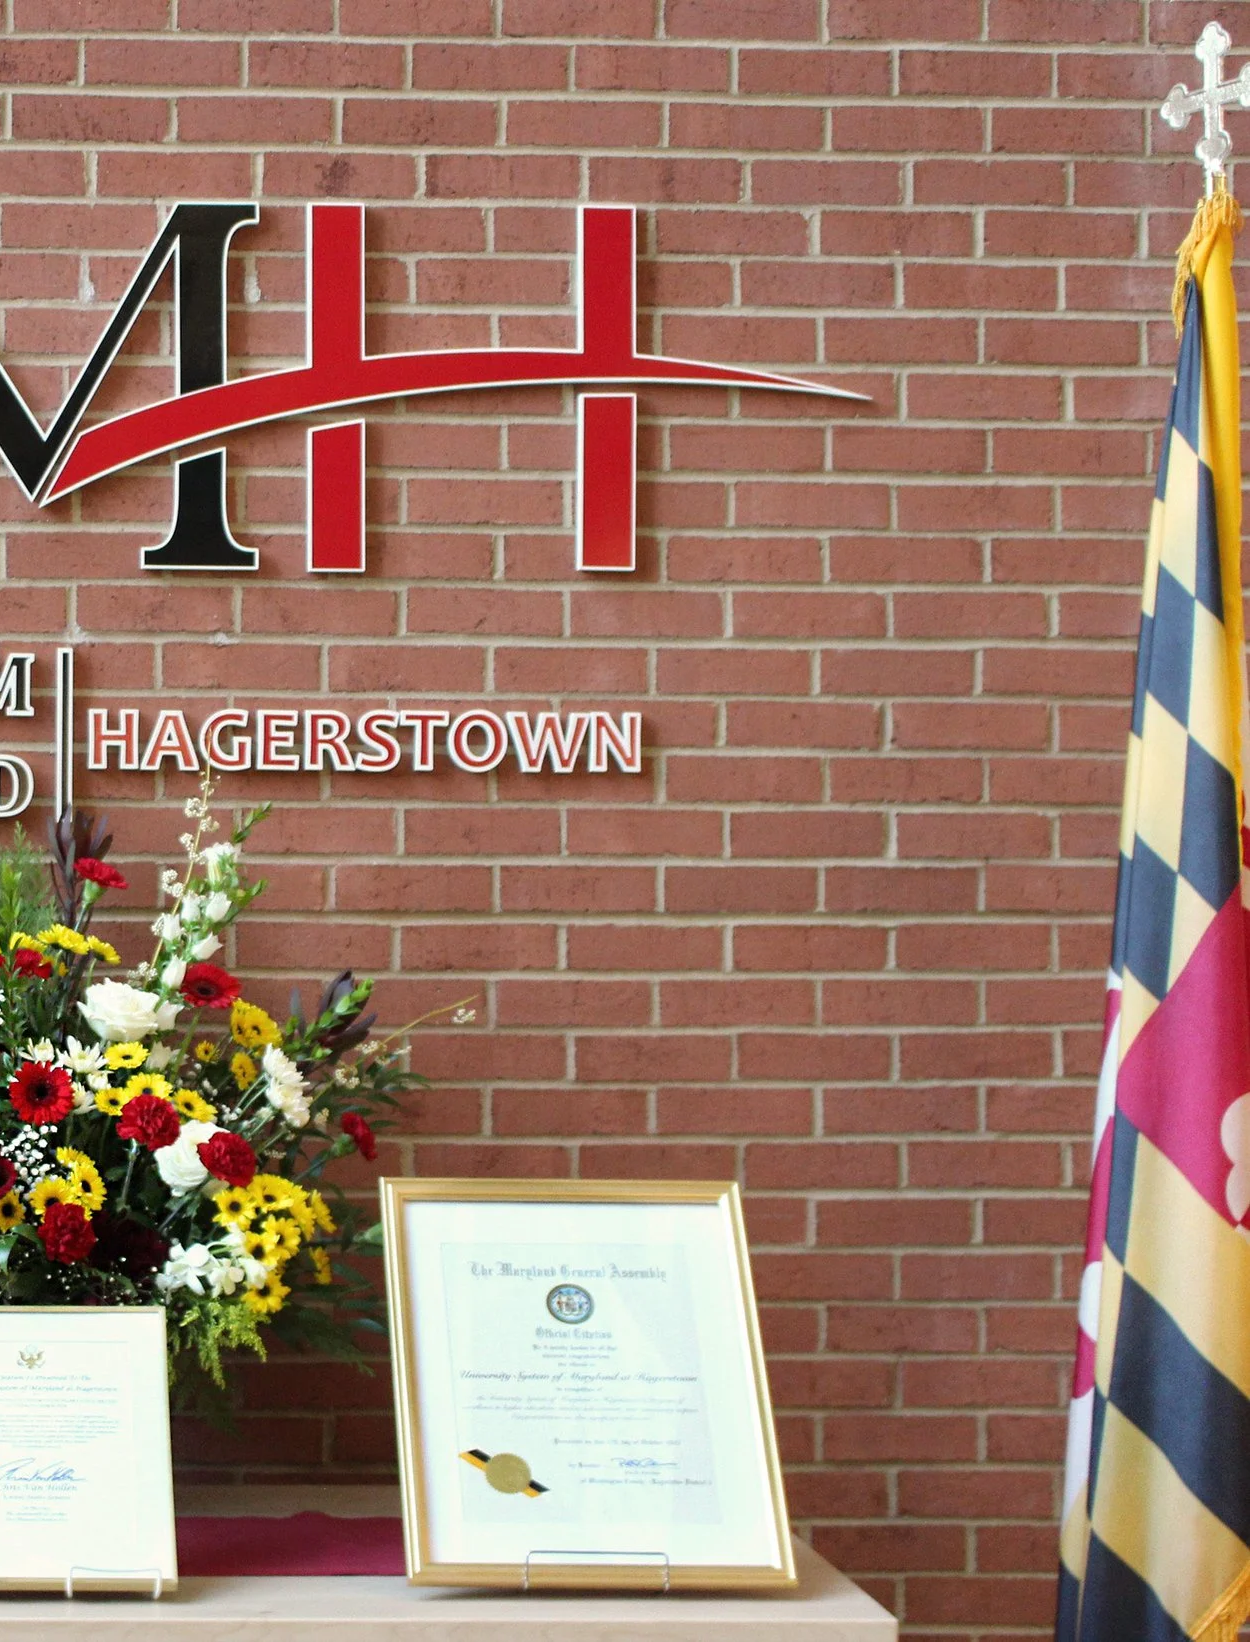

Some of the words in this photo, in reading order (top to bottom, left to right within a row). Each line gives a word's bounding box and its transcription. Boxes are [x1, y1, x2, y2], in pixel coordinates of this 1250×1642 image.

[86, 708, 643, 774] HAGERSTOWN
[467, 1260, 493, 1280] The
[495, 1260, 557, 1281] Maryland
[559, 1263, 606, 1279] General
[608, 1262, 667, 1283] Assembly
